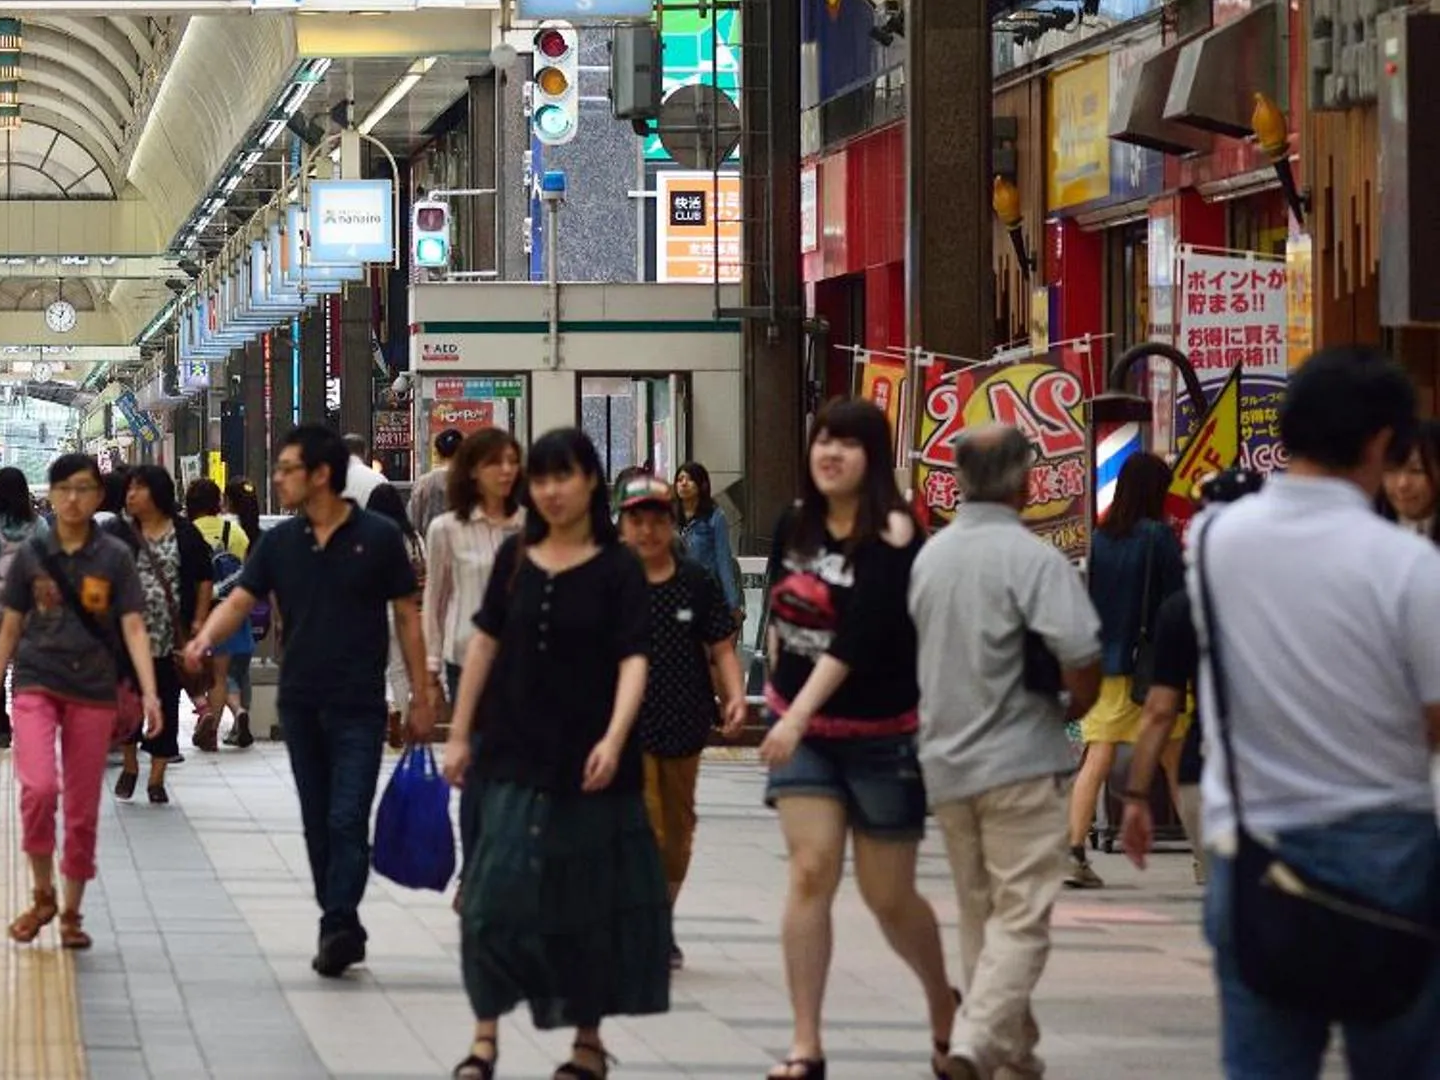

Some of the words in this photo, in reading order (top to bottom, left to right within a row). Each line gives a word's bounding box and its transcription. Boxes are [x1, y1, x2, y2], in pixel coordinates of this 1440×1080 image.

[675, 196, 702, 209] 快活
[675, 211, 702, 221] CLUB
[1188, 271, 1286, 291] ポイントが
[1188, 293, 1265, 315] 貯まる!!
